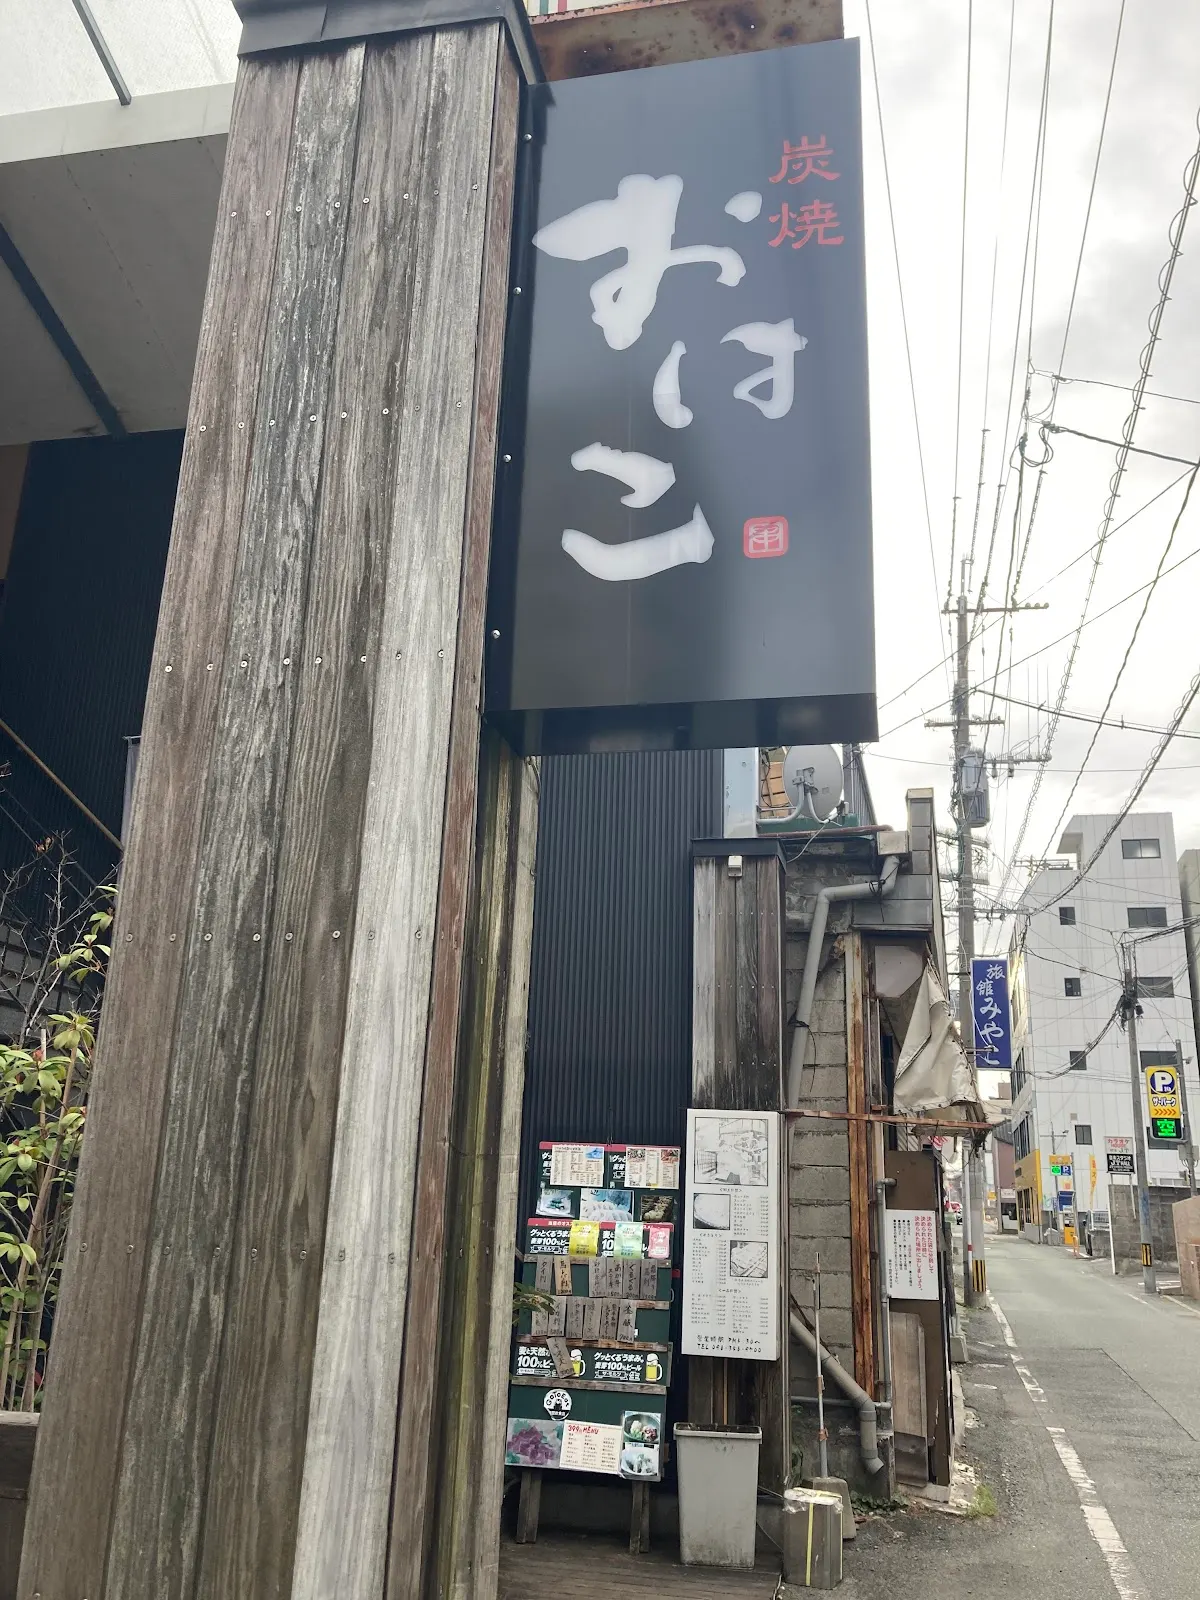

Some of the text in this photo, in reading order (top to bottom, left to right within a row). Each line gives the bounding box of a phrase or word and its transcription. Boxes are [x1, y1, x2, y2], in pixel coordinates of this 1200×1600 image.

[769, 135, 845, 250] 炭焼
[532, 173, 808, 581] おはこ
[1154, 1072, 1173, 1092] P
[1157, 1119, 1177, 1137] 空
[530, 1229, 570, 1238] グッとくるうま
[530, 1237, 569, 1246] 麦芽100%ビー
[517, 1355, 554, 1368] 100%ビー
